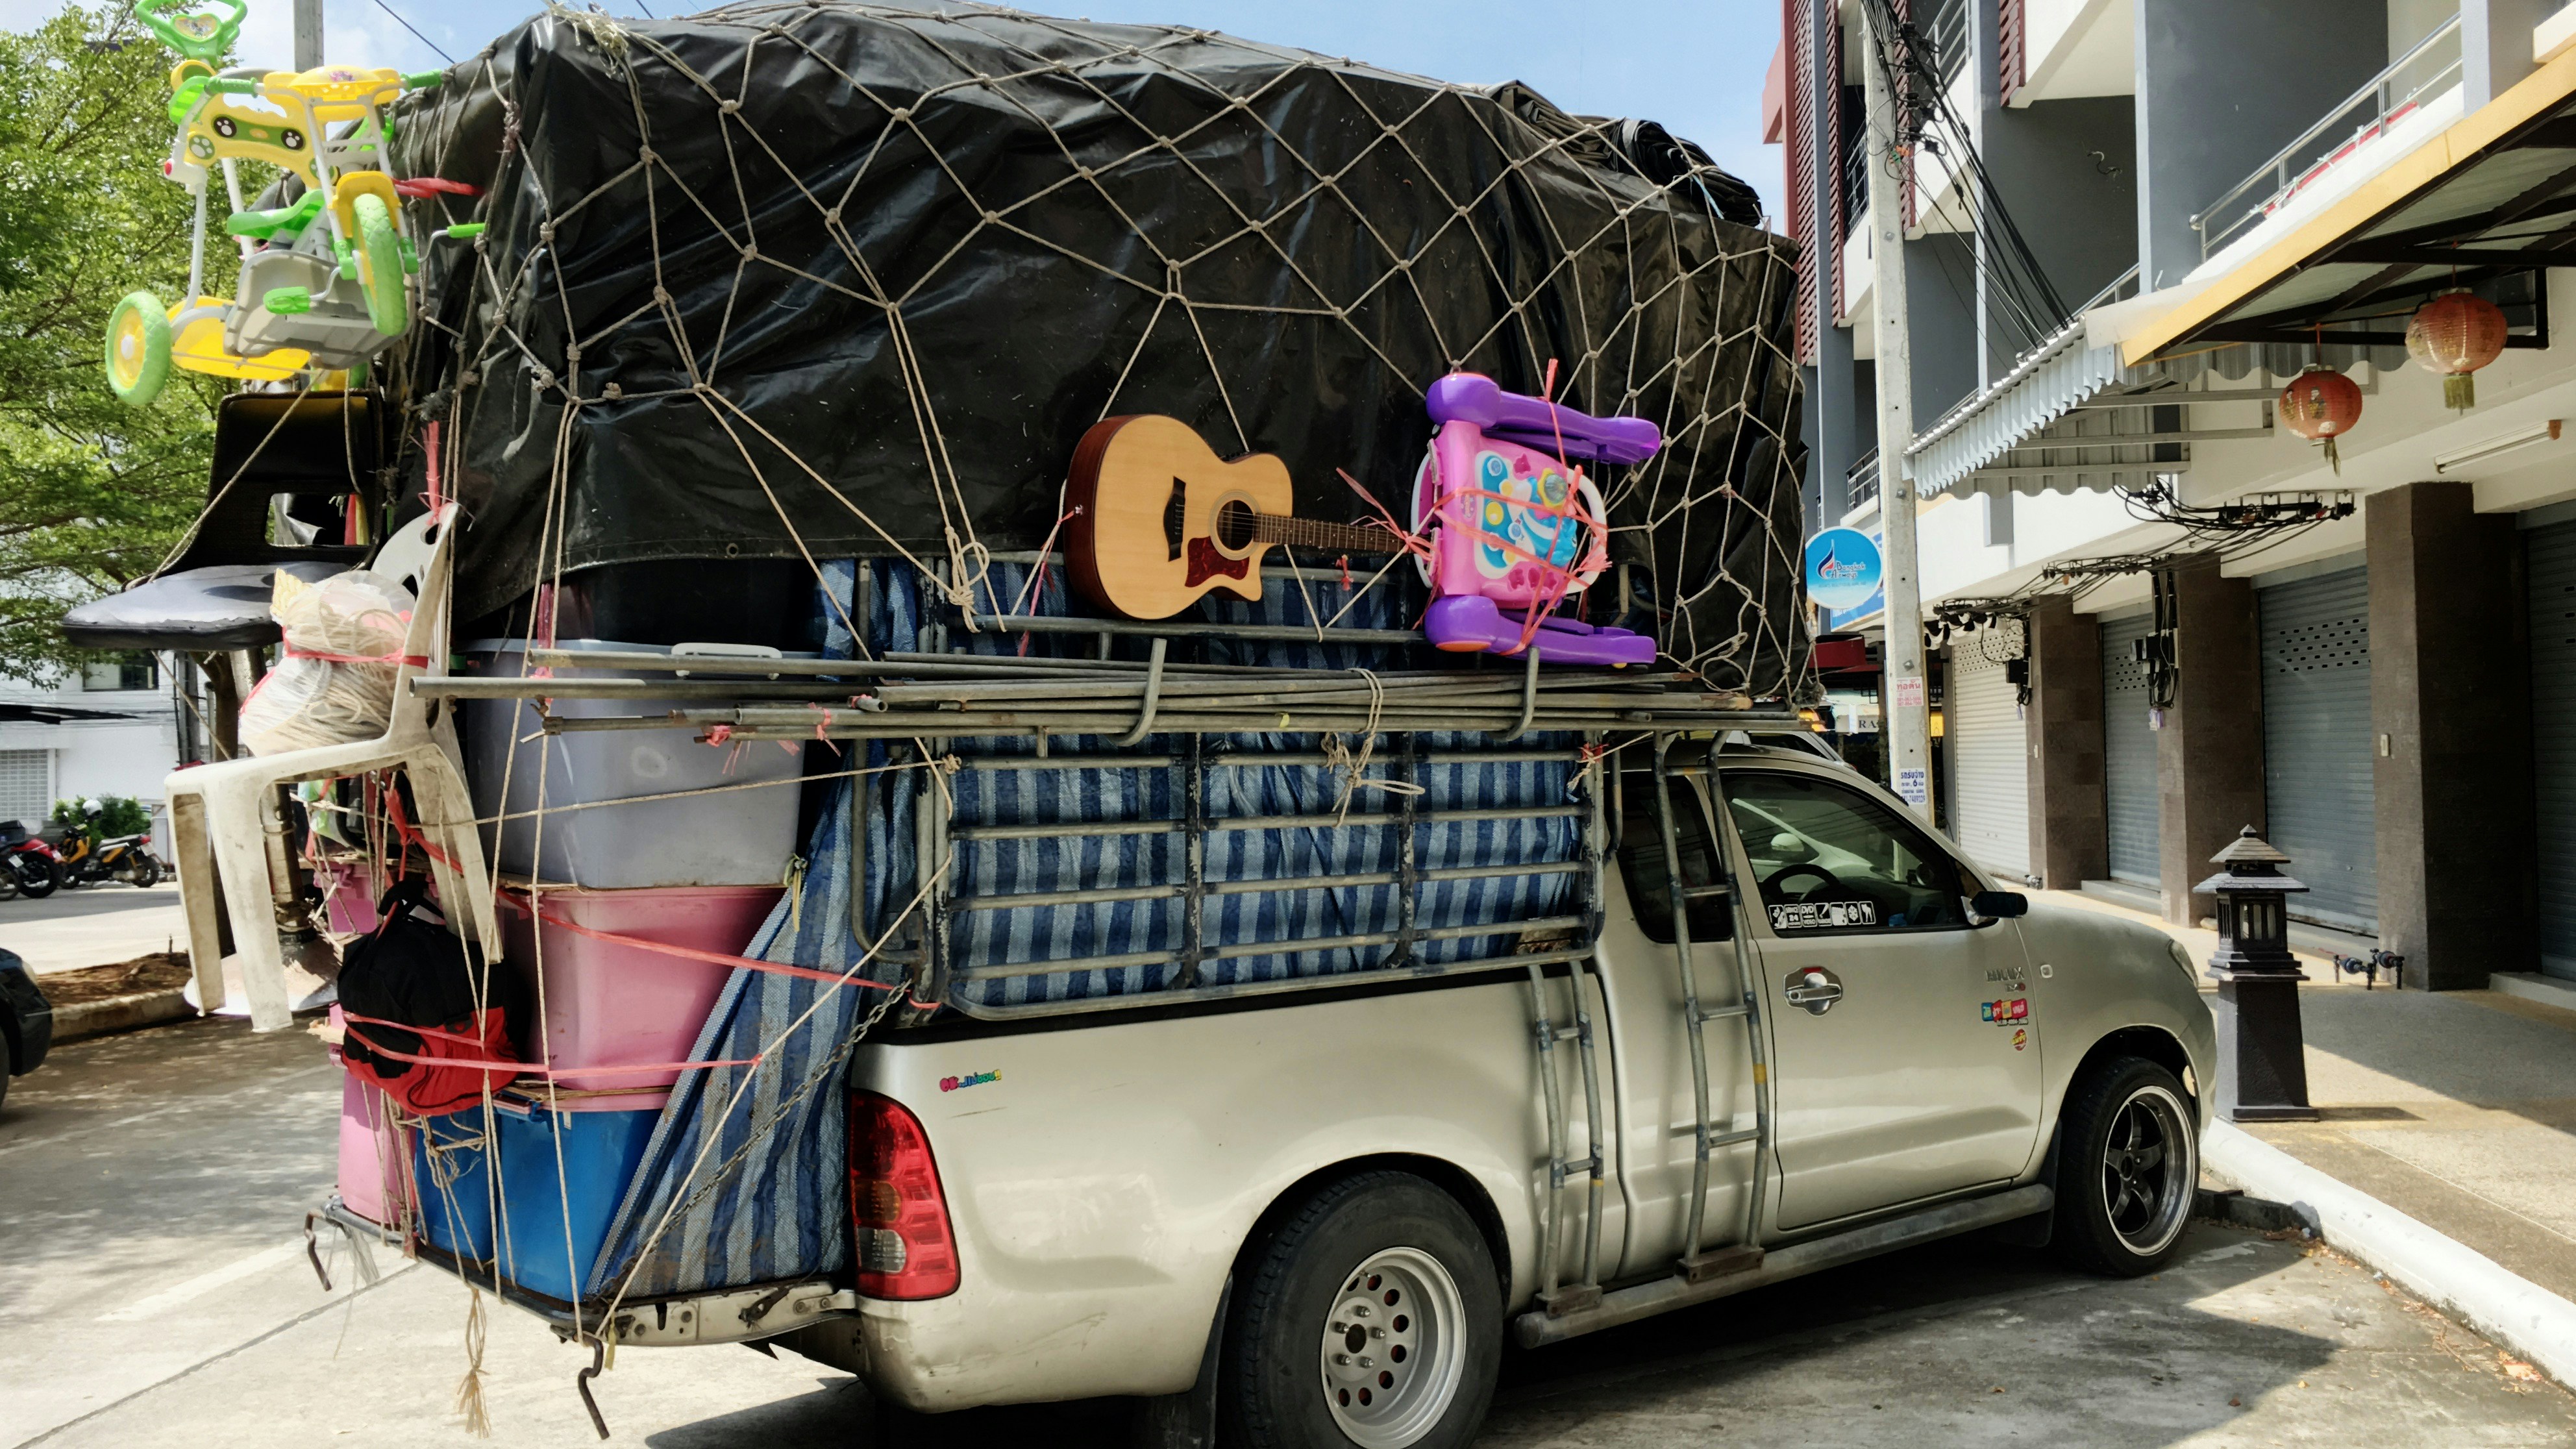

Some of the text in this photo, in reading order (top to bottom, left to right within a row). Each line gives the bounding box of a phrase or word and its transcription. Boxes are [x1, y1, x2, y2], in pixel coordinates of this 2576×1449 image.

[1837, 562, 1866, 572] Bangkok
[1831, 569, 1857, 579] Airways
[1859, 720, 1877, 728] RA
[1801, 906, 1814, 914] DVD
[1985, 967, 2025, 983] HILUX
